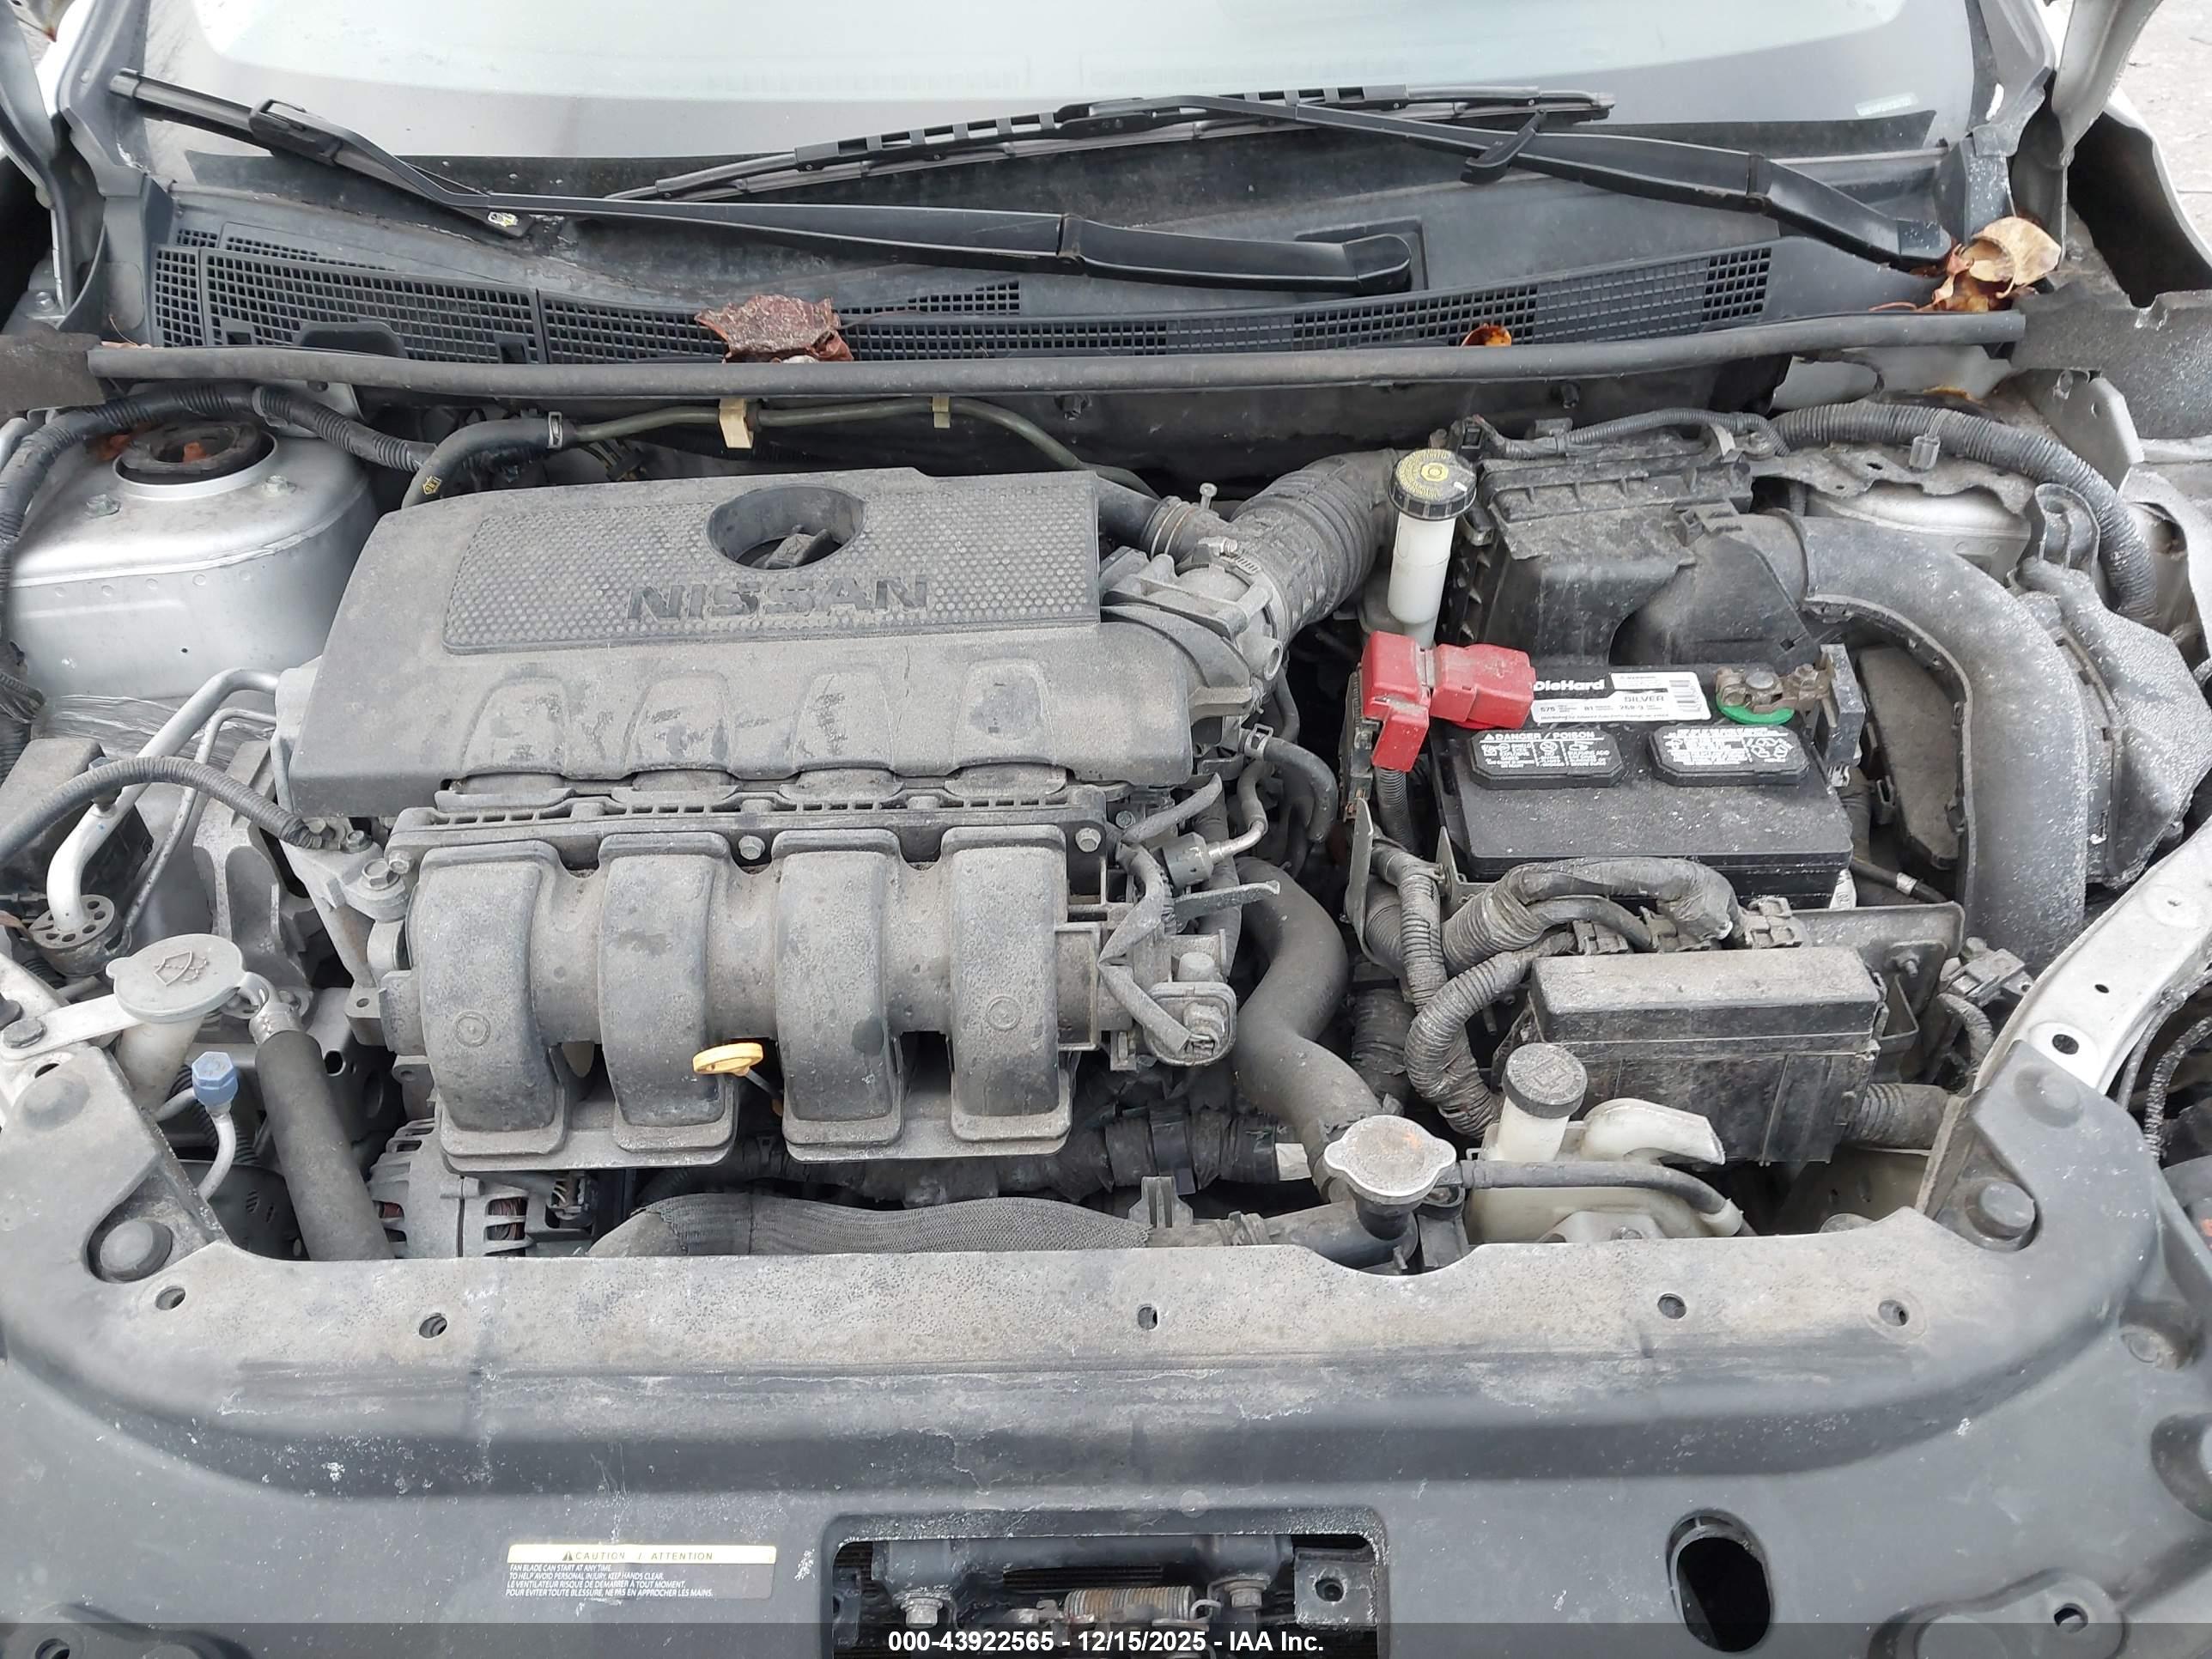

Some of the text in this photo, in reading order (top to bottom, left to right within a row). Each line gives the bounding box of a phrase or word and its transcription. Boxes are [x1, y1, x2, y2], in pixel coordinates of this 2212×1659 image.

[628, 574, 927, 620] NISSAN
[1533, 679, 1605, 691] DieHard
[1553, 731, 1595, 739] POISON
[575, 1552, 625, 1560] CAUTION
[651, 1552, 713, 1560] ATTENTION
